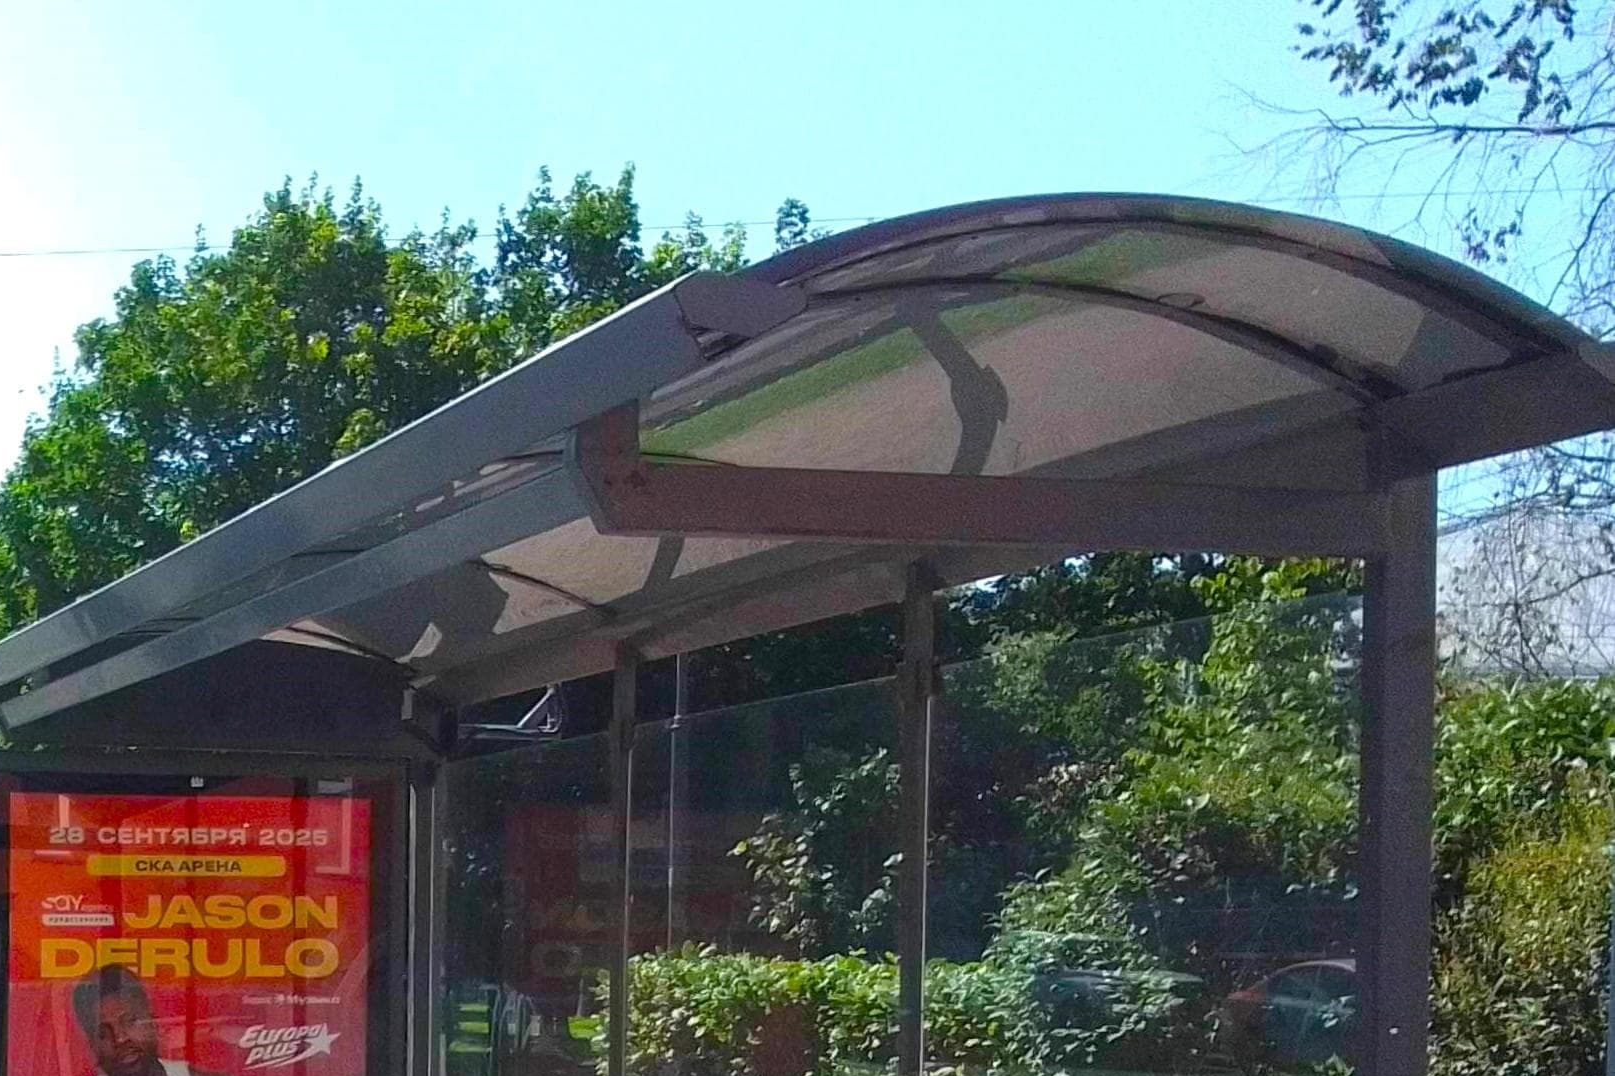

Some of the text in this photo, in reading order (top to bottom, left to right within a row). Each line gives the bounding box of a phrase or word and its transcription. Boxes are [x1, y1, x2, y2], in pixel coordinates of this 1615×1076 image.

[49, 826, 328, 846] 28 СЕНТЯБРЯ 2025
[135, 859, 243, 873] СКА АРЕНА
[123, 894, 339, 930] JASON
[39, 937, 340, 979] DERULO
